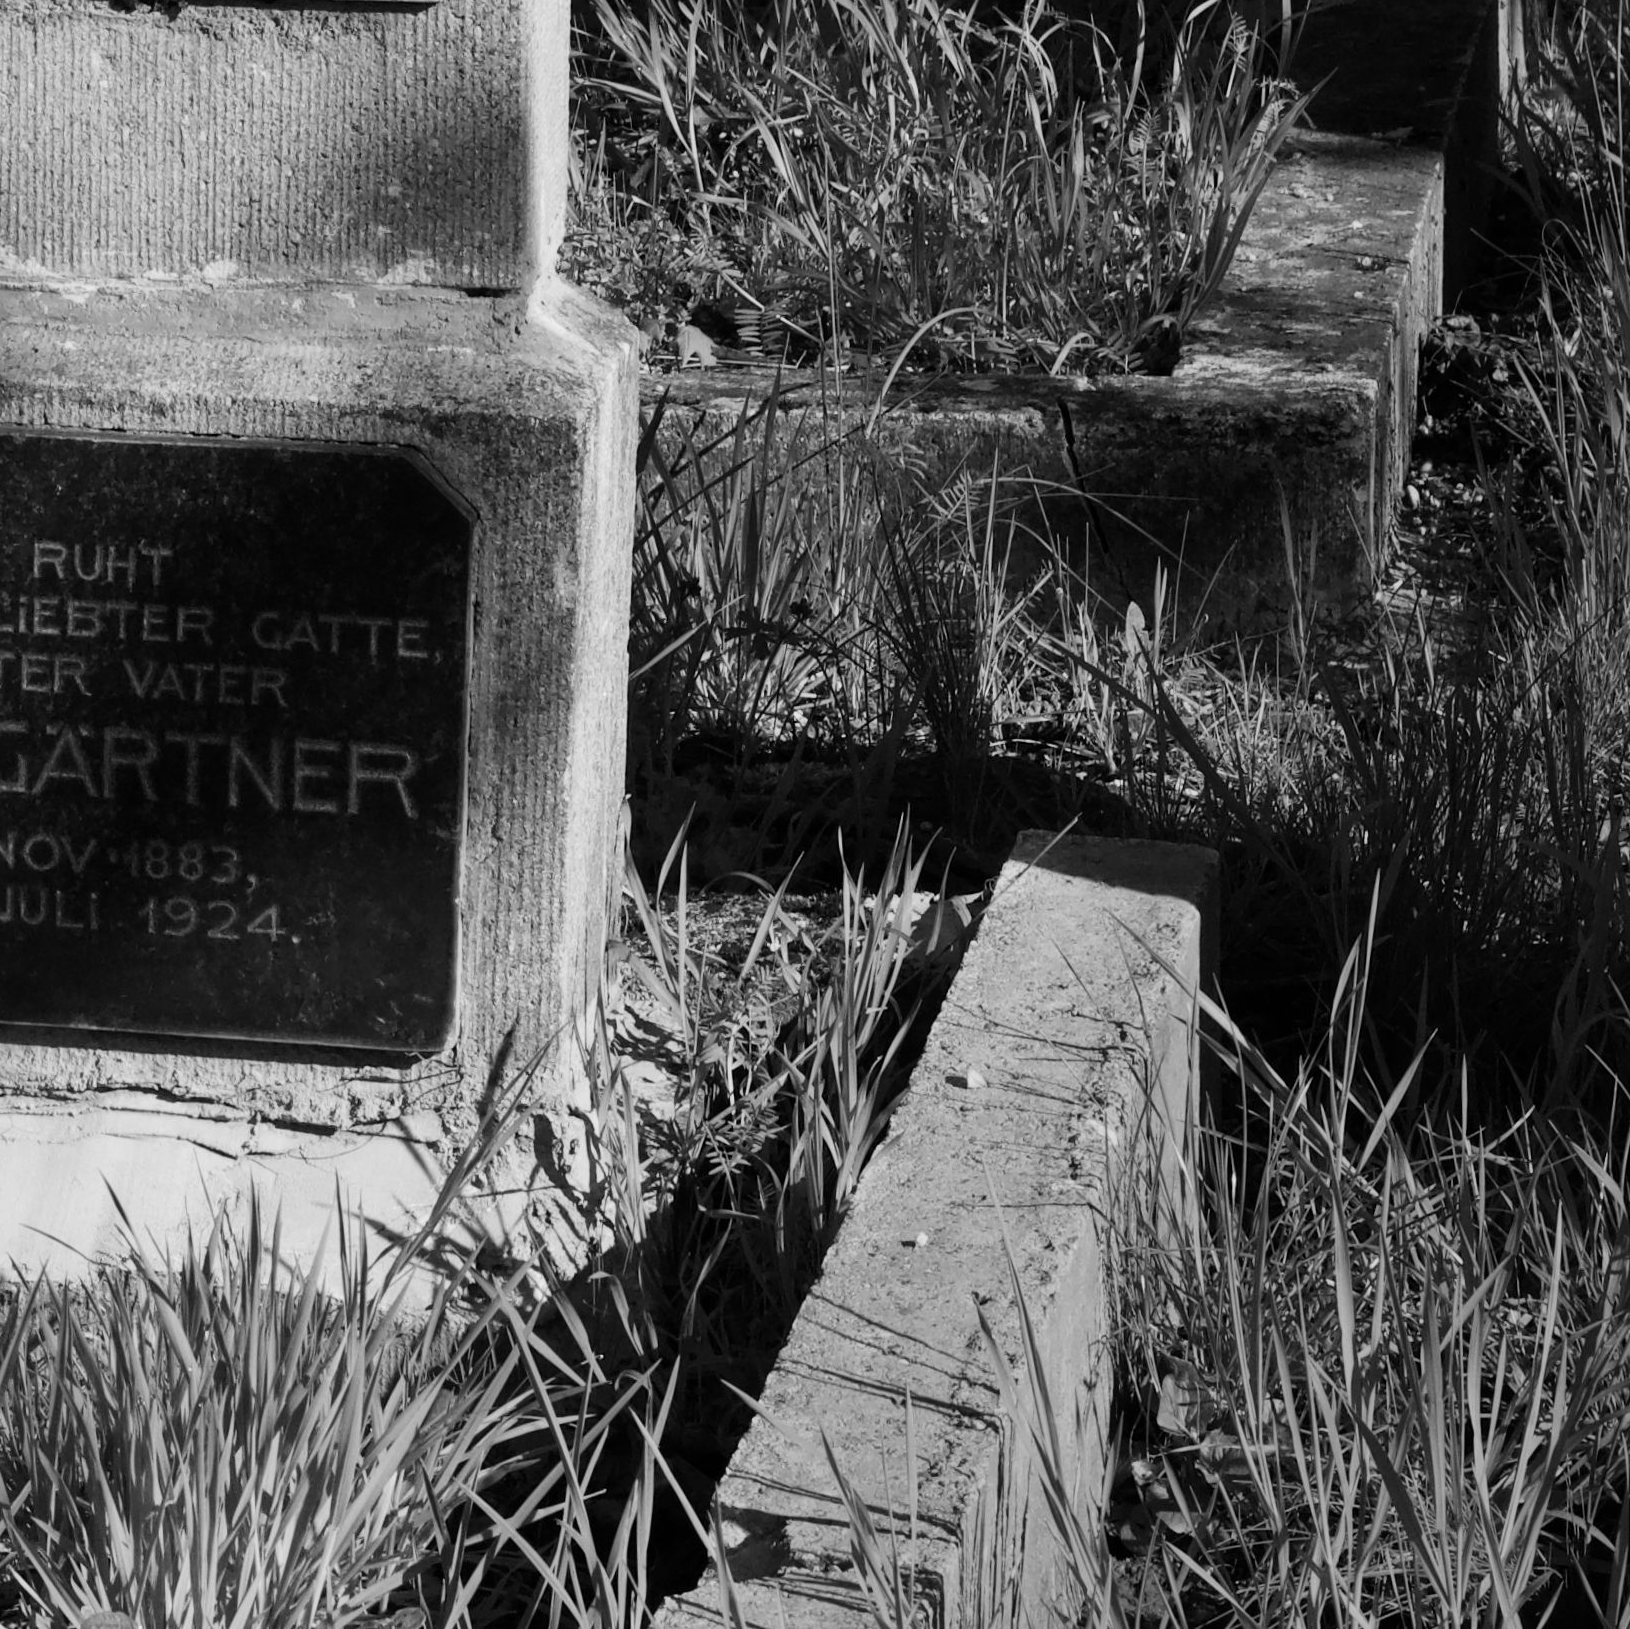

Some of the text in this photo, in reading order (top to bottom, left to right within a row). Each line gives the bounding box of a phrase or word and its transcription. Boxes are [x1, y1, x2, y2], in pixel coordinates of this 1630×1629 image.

[32, 537, 175, 589] RUHT
[251, 608, 446, 667] GATTE,
[121, 658, 291, 710] VATER
